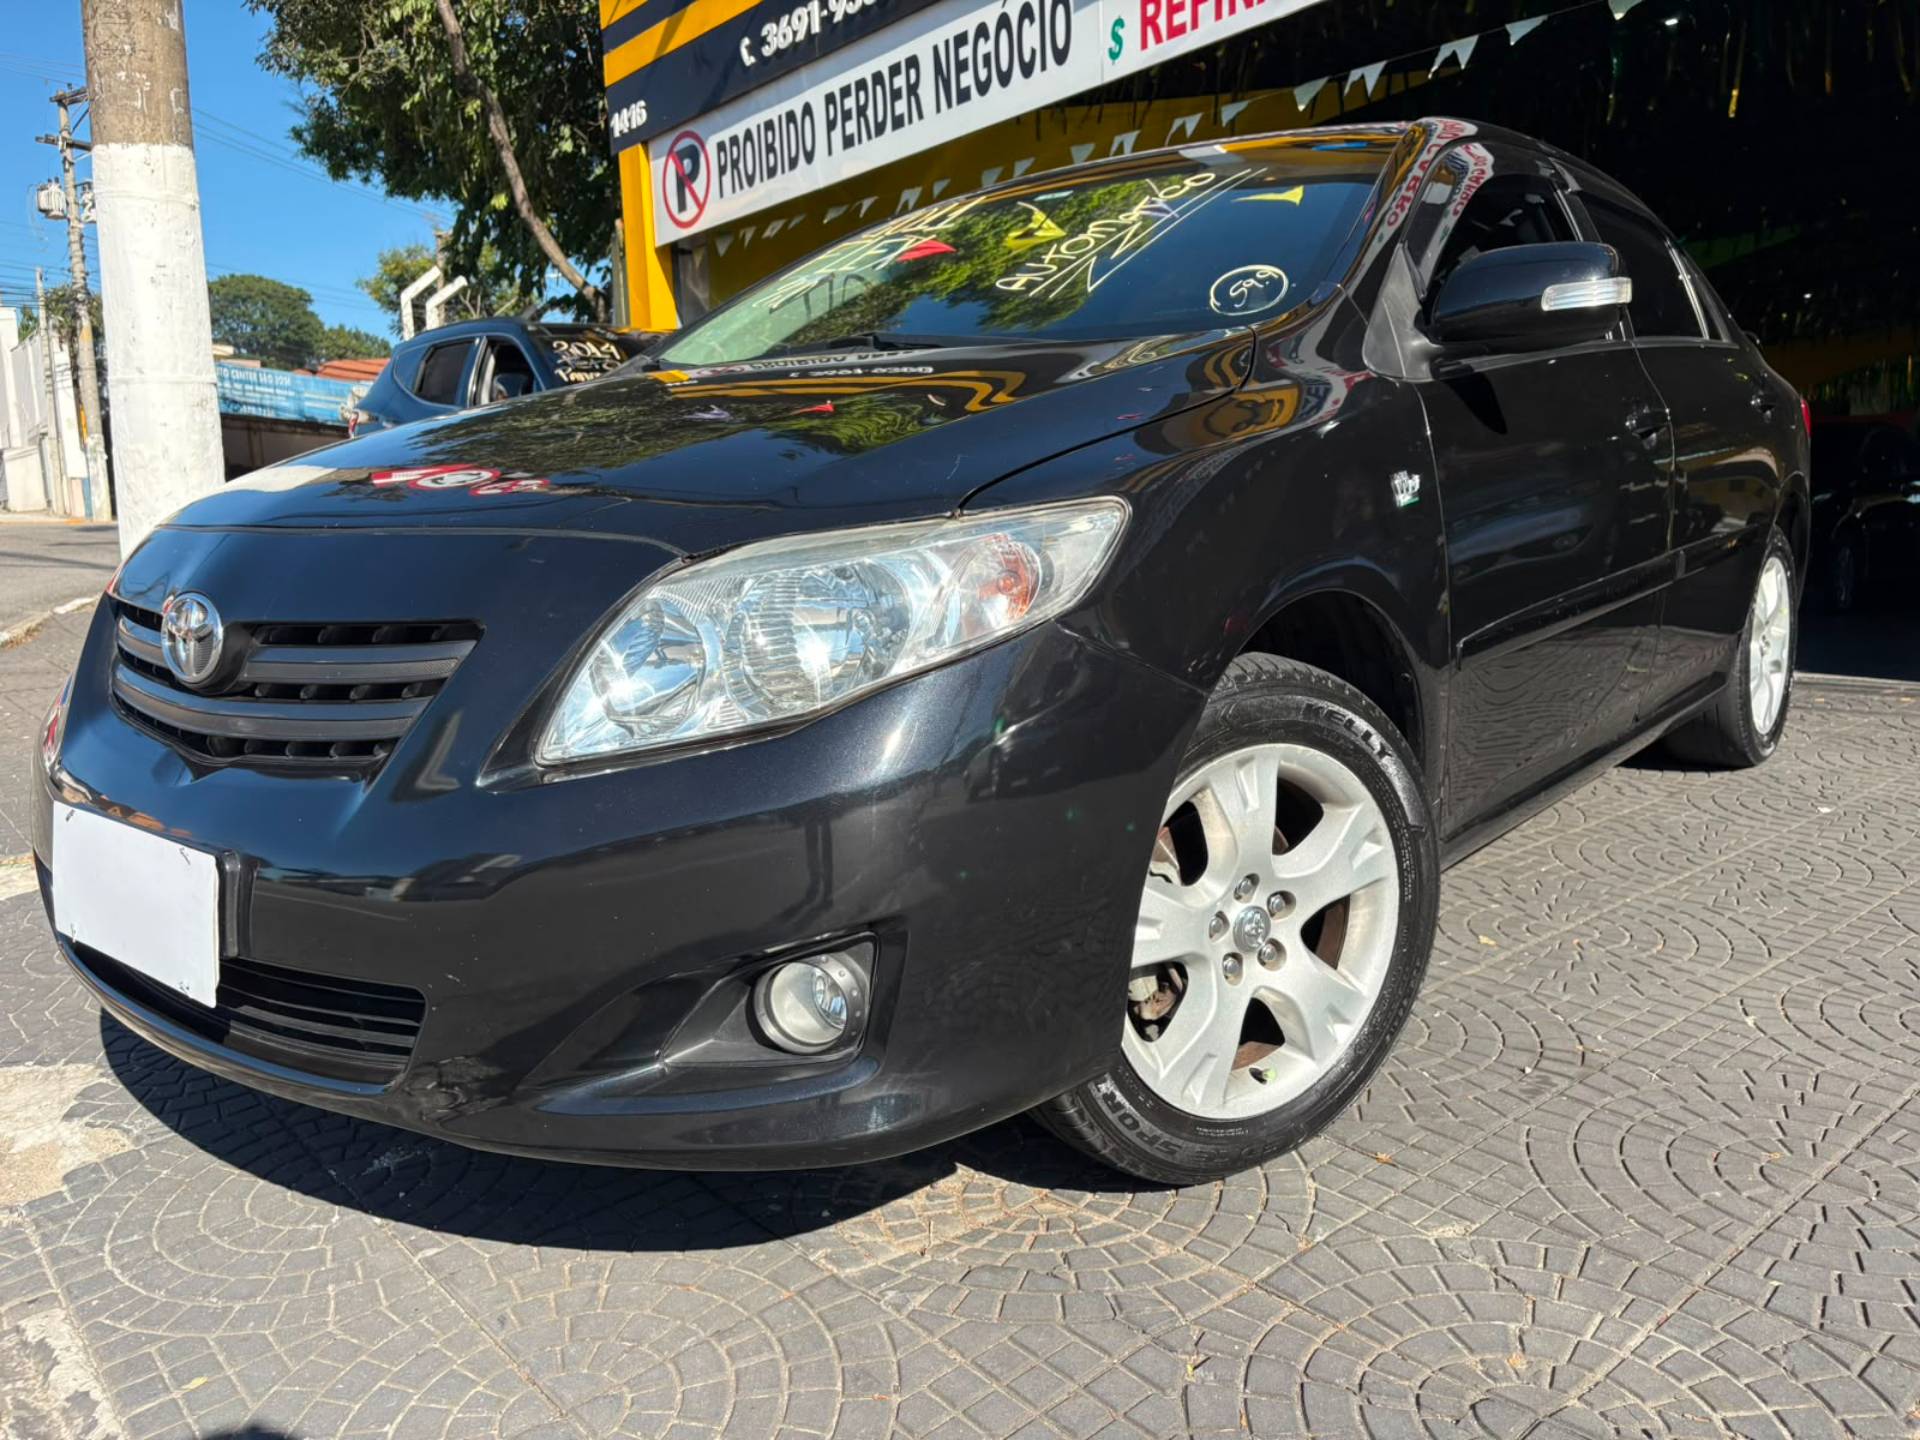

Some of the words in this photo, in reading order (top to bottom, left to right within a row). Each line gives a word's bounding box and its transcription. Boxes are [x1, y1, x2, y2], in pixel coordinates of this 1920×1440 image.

[610, 99, 647, 138] 1416
[716, 102, 816, 199] PROIBIDO
[825, 53, 924, 157] PERDER
[932, 0, 1072, 114] NEGÓCIO
[552, 340, 621, 360] 2014
[1300, 701, 1393, 760] KELLY
